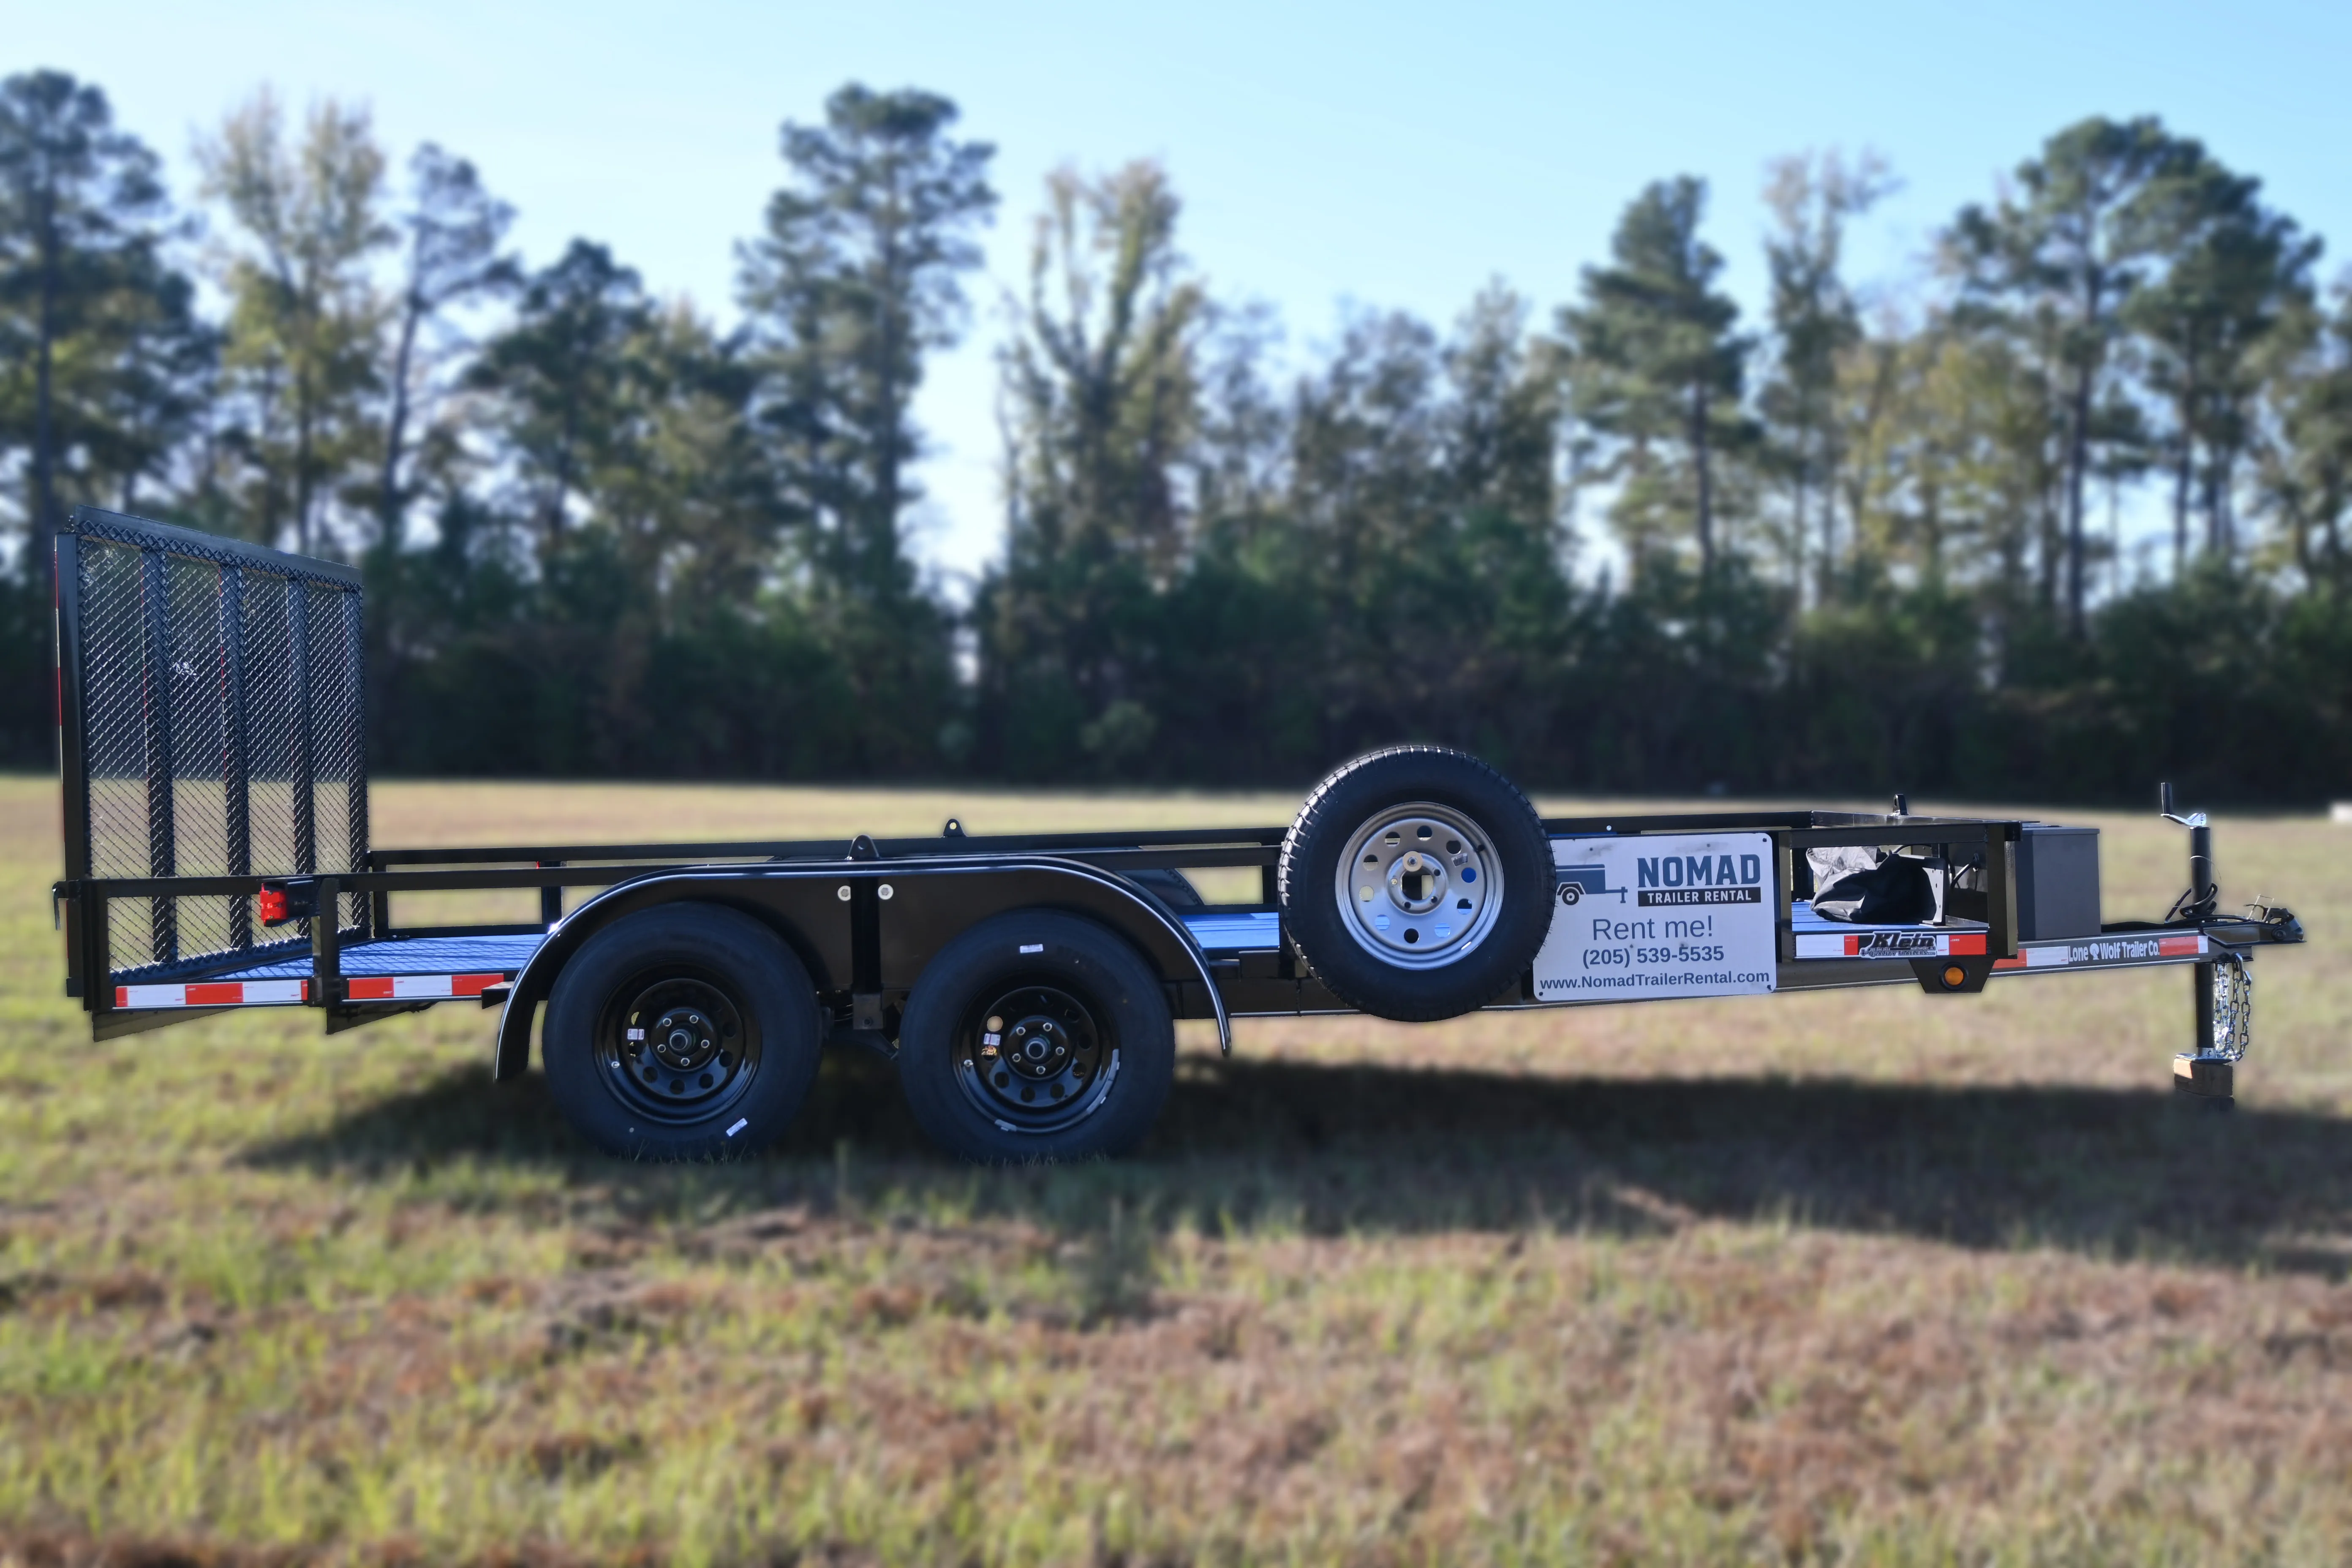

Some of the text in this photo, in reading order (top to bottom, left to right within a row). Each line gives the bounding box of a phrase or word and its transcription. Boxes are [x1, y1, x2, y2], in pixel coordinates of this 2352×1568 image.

[1637, 854, 1761, 887] NOMAD
[1648, 888, 1752, 904] TRAILER RENTAL
[1593, 915, 1713, 940] Rent me!
[1870, 932, 1934, 947] Klein
[1583, 945, 1724, 969] (205) 539-5535
[2069, 940, 2160, 962] Lone Wolf Trailer Co.
[1540, 971, 1769, 989] www.NomadTrailerRental.com
